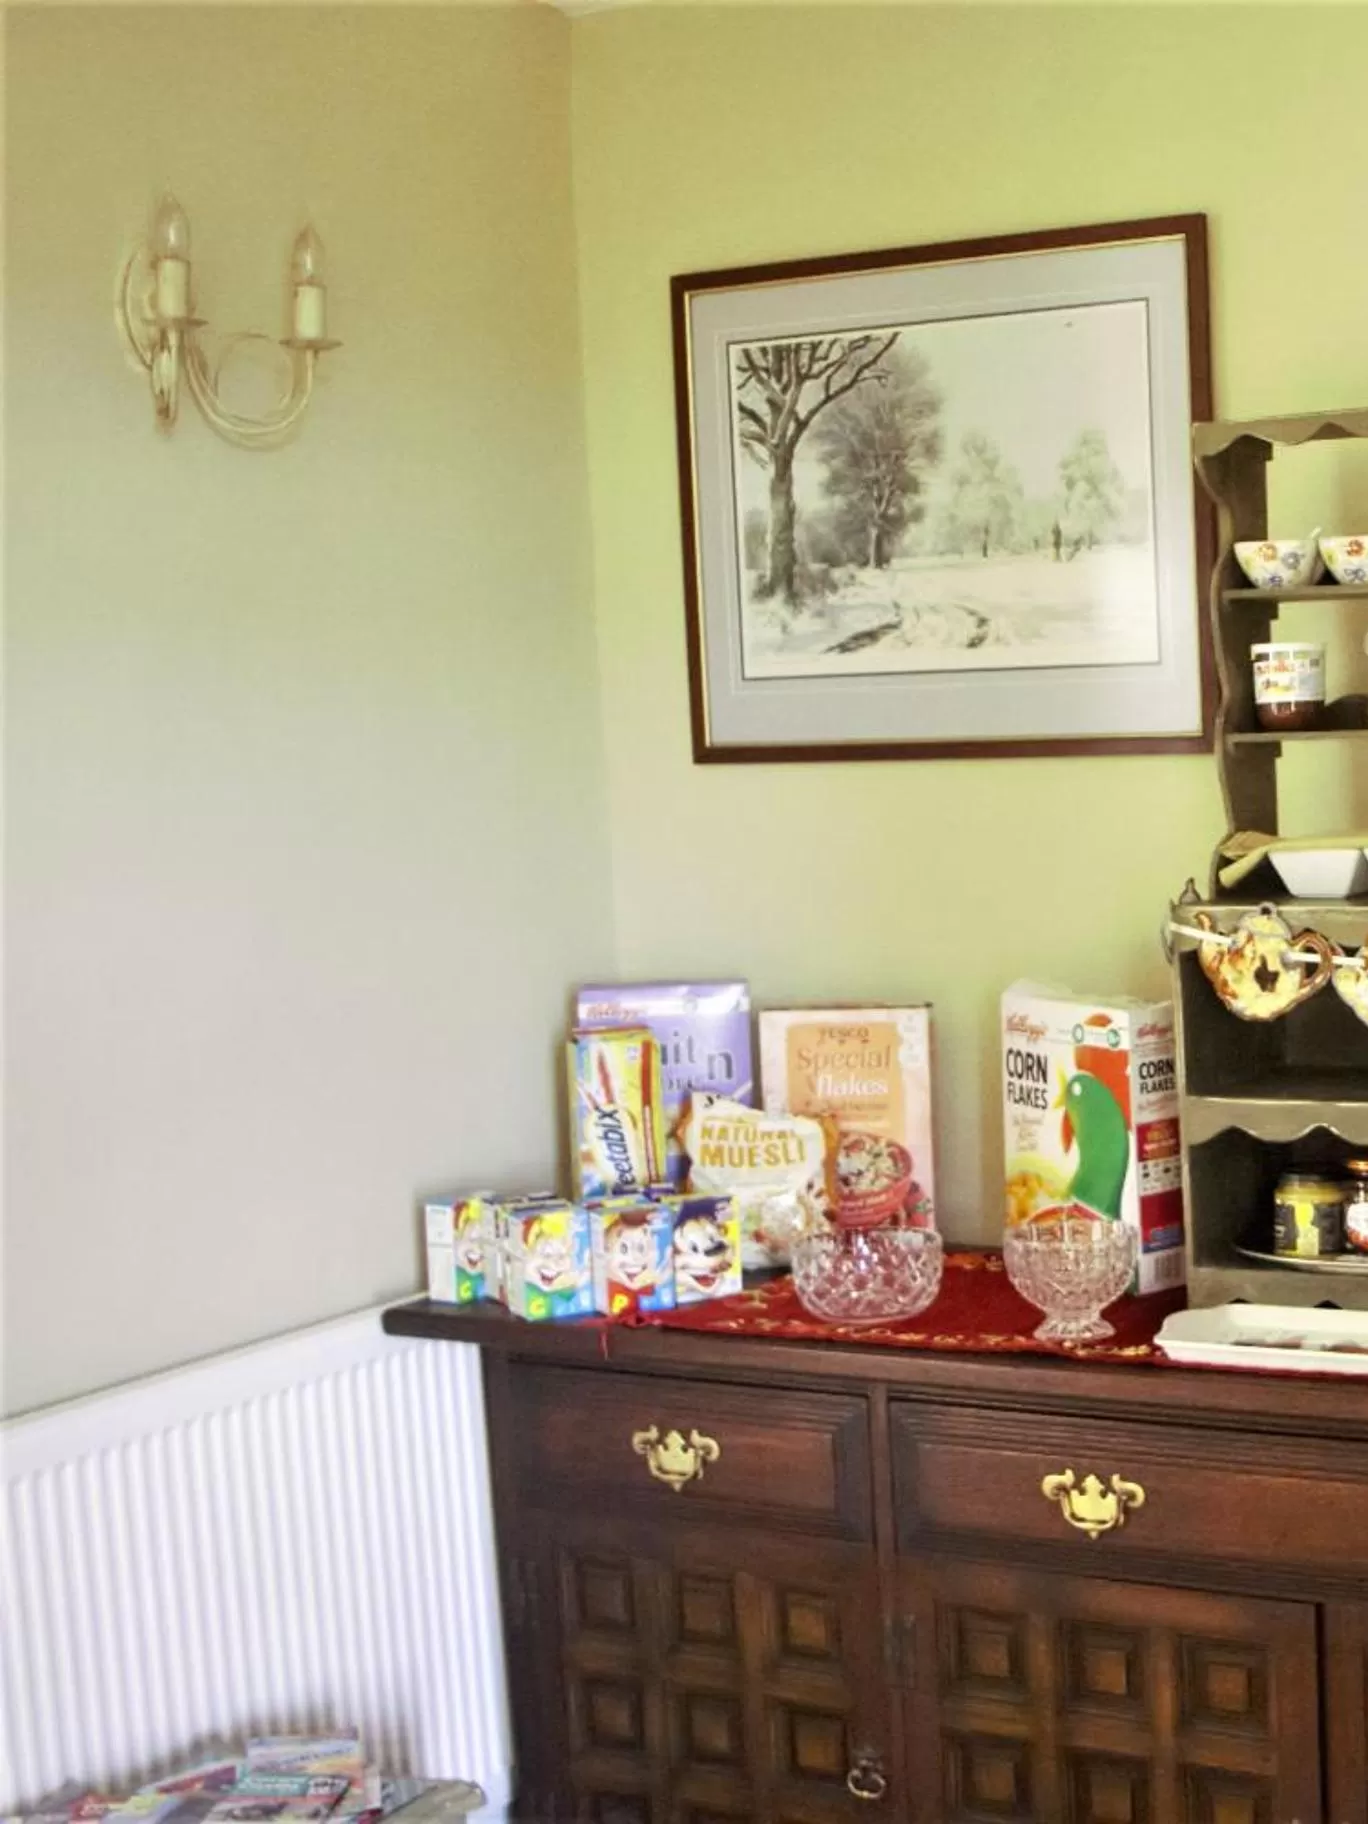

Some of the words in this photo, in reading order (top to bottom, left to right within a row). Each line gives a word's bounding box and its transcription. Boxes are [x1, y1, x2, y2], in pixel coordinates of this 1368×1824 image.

[797, 1045, 892, 1077] Special
[1006, 1047, 1048, 1084] CORN
[1139, 1059, 1175, 1080] CORN
[816, 1070, 890, 1098] flakes
[1007, 1081, 1048, 1110] FLAKES
[700, 1138, 807, 1169] MUESLI
